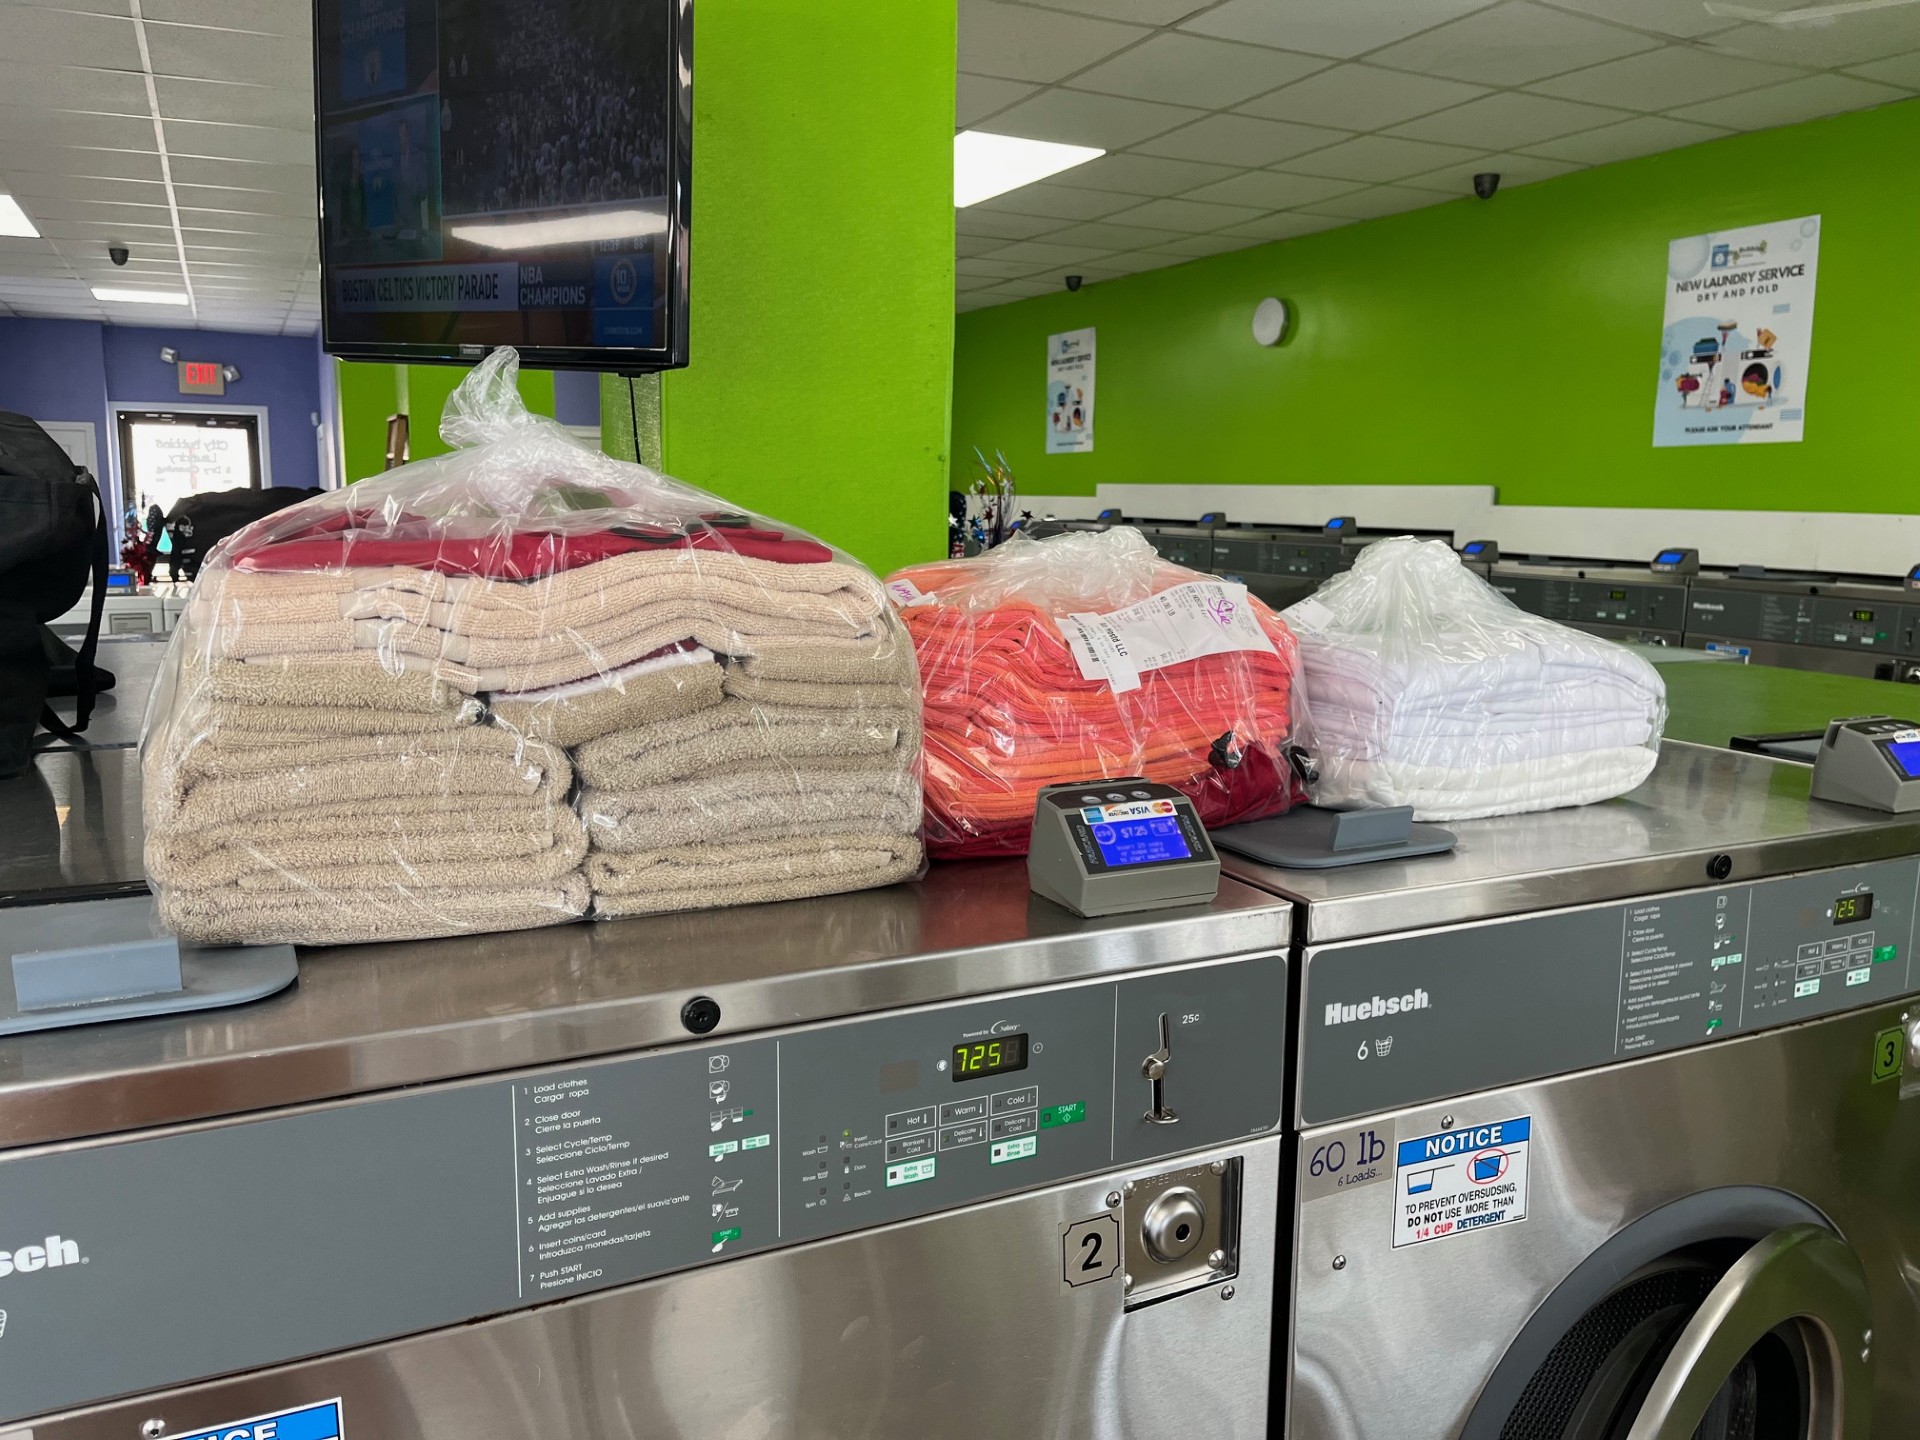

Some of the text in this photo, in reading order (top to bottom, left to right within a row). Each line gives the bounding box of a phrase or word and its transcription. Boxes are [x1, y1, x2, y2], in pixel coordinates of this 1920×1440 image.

[519, 266, 543, 284] NBA
[1676, 279, 1701, 293] NEW
[1703, 271, 1754, 289] LAUNDRY
[1758, 264, 1805, 282] SERVICE
[341, 273, 499, 302] BOSTON CELTICS VICTORY PARADE
[520, 285, 586, 305] CHAMPIONS
[1697, 284, 1779, 303] DRY AND FOLD
[186, 363, 217, 385] EXIT
[1115, 643, 1128, 657] LLC
[1129, 806, 1151, 815] VISA
[1325, 988, 1429, 1026] Huebsch
[957, 1043, 1000, 1072] 725
[1357, 1040, 1368, 1060] 6
[1883, 1040, 1895, 1068] 3
[534, 1083, 555, 1094] Load
[557, 1078, 587, 1089] clothes
[534, 1088, 589, 1104] Cargar ropa
[535, 1113, 559, 1125] Close
[560, 1109, 581, 1121] door
[907, 1095, 1025, 1125] Hot Warm Cold
[1058, 1104, 1077, 1114] START
[535, 1116, 601, 1135] Cierre la puerta
[954, 1117, 1026, 1137] Delicate Delicate
[536, 1143, 562, 1154] Select
[564, 1134, 612, 1149] Cycle/Temp
[906, 1146, 921, 1154] Cold
[957, 1135, 973, 1143] Warm
[1425, 1126, 1503, 1158] NOTICE
[536, 1140, 630, 1165] Seleccione Ciclo/Temp
[1310, 1140, 1345, 1177] 60
[537, 1173, 563, 1184] Select
[565, 1168, 584, 1178] Extra
[586, 1159, 630, 1174] Wash/Rinse
[640, 1152, 669, 1164] desired
[1144, 1165, 1204, 1189] GREEWALD
[537, 1180, 583, 1194] Seleccione
[586, 1173, 617, 1185] Lavado
[619, 1167, 637, 1178] Extra
[1338, 1176, 1343, 1187] 6
[537, 1190, 576, 1204] Enjuague
[587, 1186, 594, 1195] lo
[597, 1181, 622, 1192] desea
[1405, 1182, 1517, 1215] TO PREVENT OVERSUDSING,
[538, 1212, 556, 1223] Add
[558, 1205, 591, 1219] supplies
[538, 1219, 572, 1233] Agregar
[575, 1215, 585, 1224] los
[587, 1204, 646, 1223] detergentes/el
[1408, 1196, 1514, 1228] DO NOT USE MORE THAN
[1416, 1210, 1506, 1240] 1/4 CUP DETERGENT
[539, 1239, 561, 1250] Insert
[563, 1229, 606, 1245] coins/card
[539, 1229, 650, 1261] Introduzca monedas/tarjeta
[1081, 1231, 1103, 1272] 2
[540, 1269, 558, 1280] Push
[561, 1263, 582, 1274] START
[540, 1268, 603, 1290] Presione INICIO
